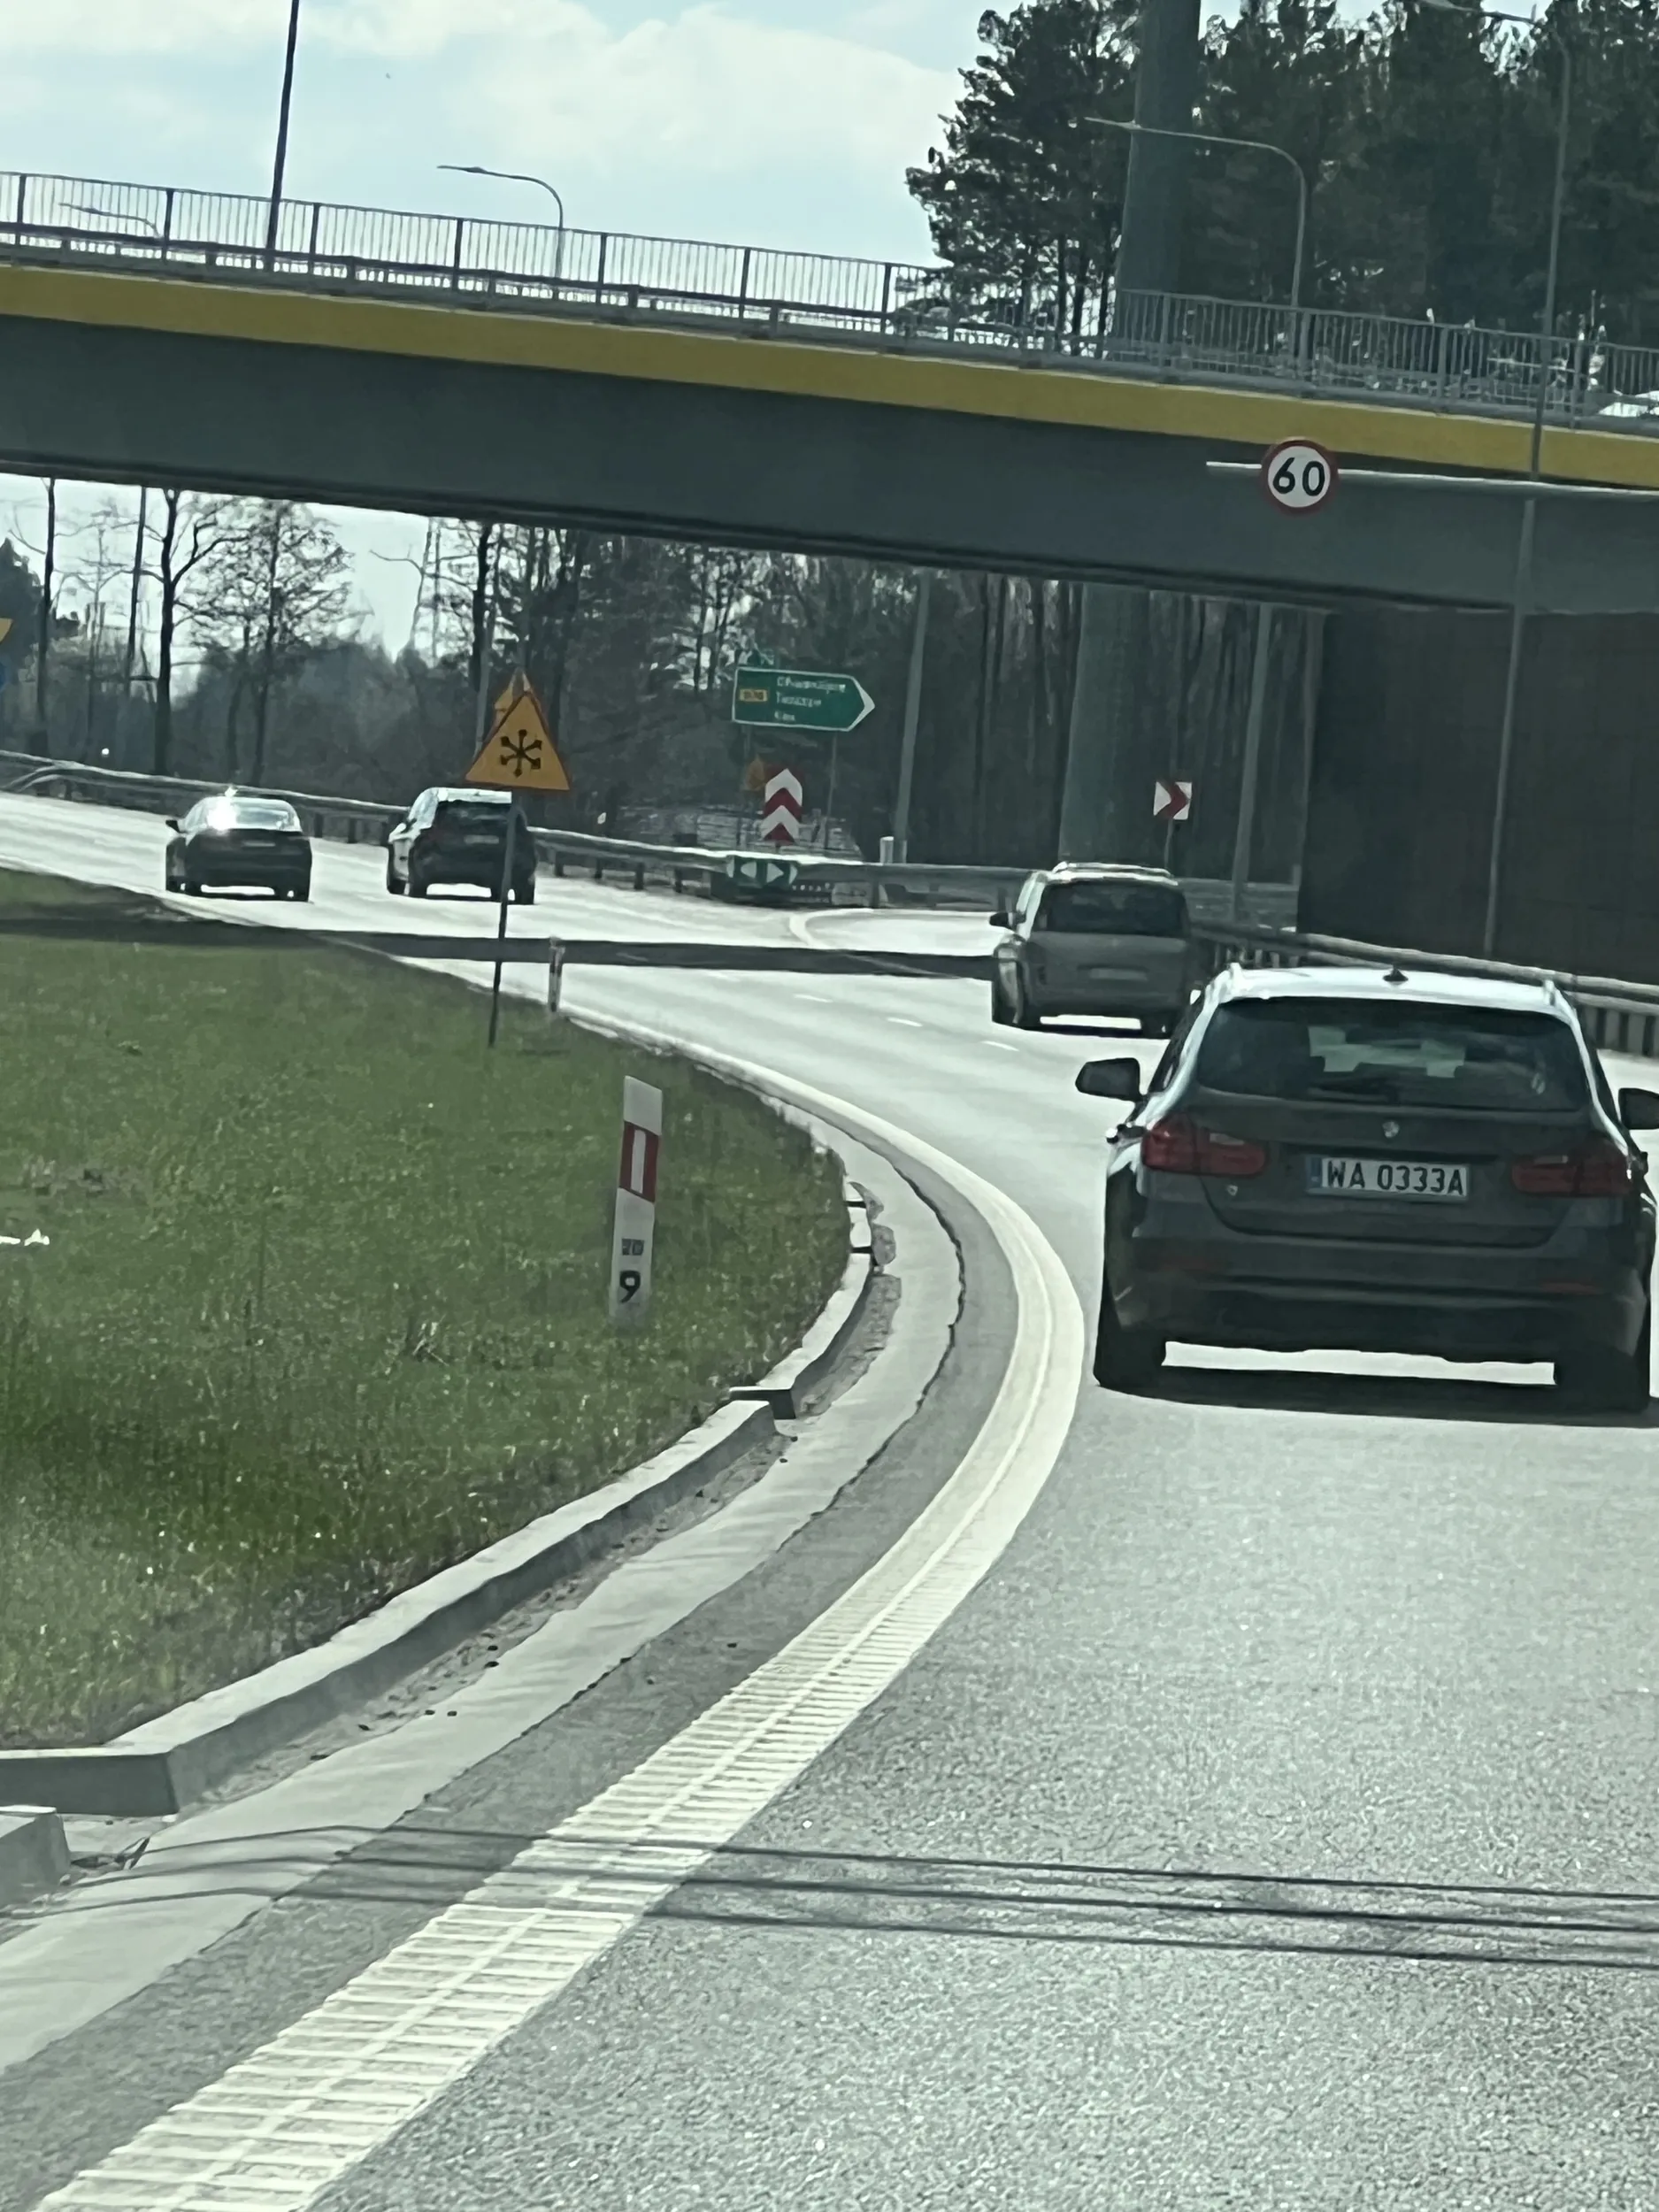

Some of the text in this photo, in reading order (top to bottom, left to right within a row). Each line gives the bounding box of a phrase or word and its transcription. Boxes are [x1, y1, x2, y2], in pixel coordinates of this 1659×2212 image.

[1272, 457, 1325, 496] 60
[1327, 1160, 1463, 1195] WA 0333A
[619, 1270, 641, 1303] 9
